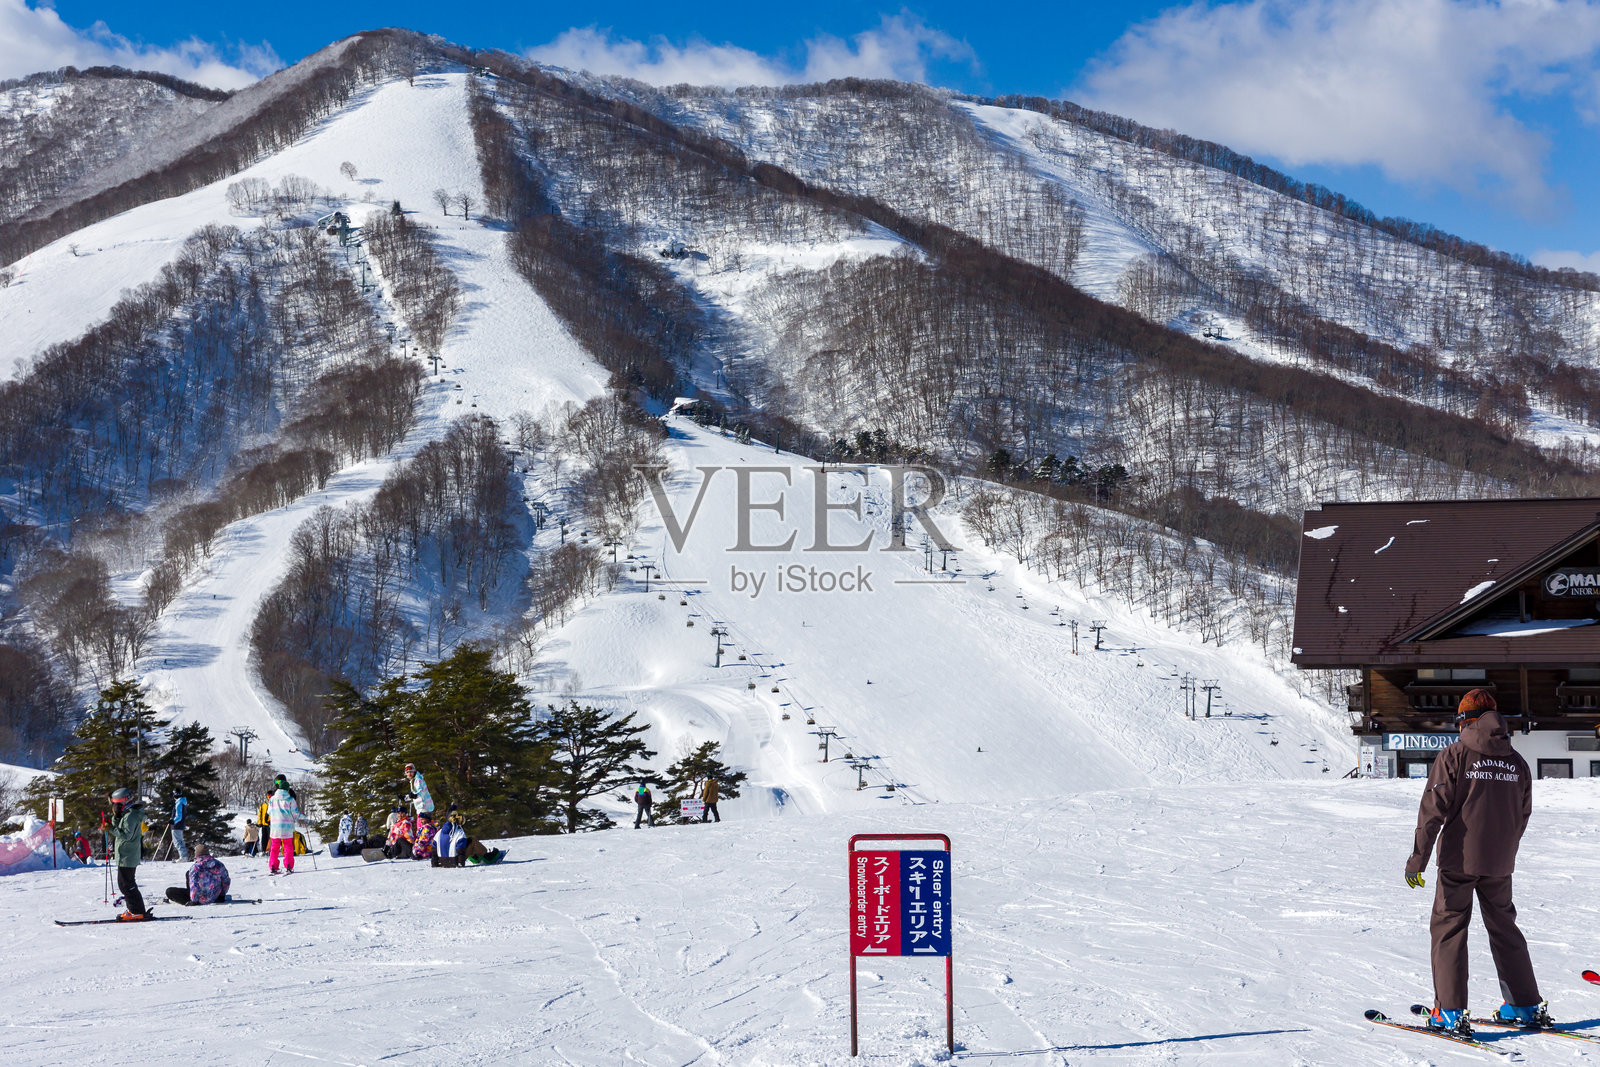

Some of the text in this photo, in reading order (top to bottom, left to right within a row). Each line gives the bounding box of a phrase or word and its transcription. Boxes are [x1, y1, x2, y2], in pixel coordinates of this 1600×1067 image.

[1465, 771, 1520, 782] SPORTS ACADEMY
[1472, 759, 1516, 772] MADARAO
[856, 856, 868, 938] Snowboarder entry
[873, 856, 891, 944] スノーボードエリア
[909, 857, 928, 943] スキーエリア
[932, 860, 944, 938] Skier entry
